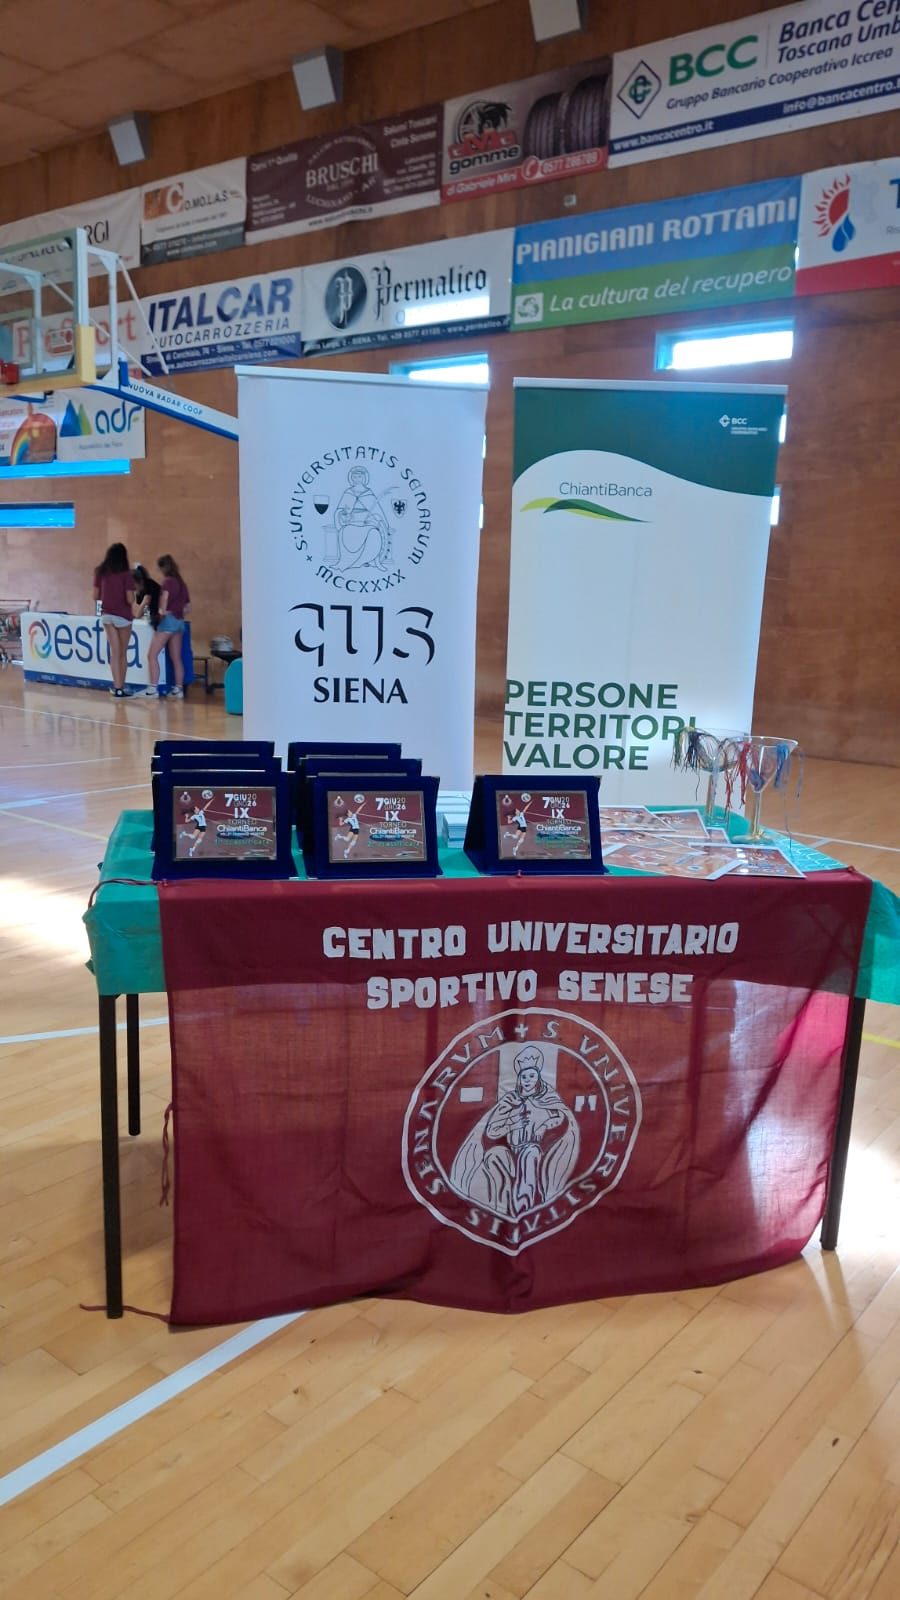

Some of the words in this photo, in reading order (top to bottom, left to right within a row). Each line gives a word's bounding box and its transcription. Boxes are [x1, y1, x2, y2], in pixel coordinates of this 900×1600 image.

[779, 9, 851, 44] Banca
[669, 35, 758, 86] BCC
[777, 32, 853, 64] Toscana
[666, 91, 709, 110] Gruppo
[711, 76, 766, 100] Bancario
[768, 57, 848, 86] Cooperativo
[852, 47, 893, 66] Iccrea
[613, 120, 714, 151] www.bancacentro.it
[306, 153, 379, 189] BRUSCHI
[450, 145, 520, 175] gomme
[515, 222, 653, 265] PIANIGIANI
[662, 197, 797, 241] ROTTAMI
[371, 259, 487, 321] Permalico
[550, 294, 573, 312] La
[579, 282, 648, 308] cultura
[654, 279, 688, 299] del
[692, 266, 792, 293] recupero
[147, 277, 293, 335] ITALCAR
[156, 392, 180, 407] RADAR
[731, 417, 748, 425] BCC
[559, 481, 653, 497] ChiantiBanca
[54, 619, 142, 669] esta
[313, 677, 408, 704] SIENA
[505, 679, 679, 709] PERSONE
[503, 740, 649, 771] VALORE
[224, 793, 233, 807] 7
[234, 807, 250, 818] IX
[375, 797, 384, 810] 7
[542, 796, 550, 808] 7
[551, 809, 565, 818] IX
[217, 824, 267, 832] ChiantiBanca
[385, 811, 400, 821] IX
[322, 925, 467, 959] CENTRO
[487, 920, 740, 956] UNIVERSITARIO
[366, 969, 538, 1009] SPORTIVO
[557, 970, 694, 1004] SENESE
